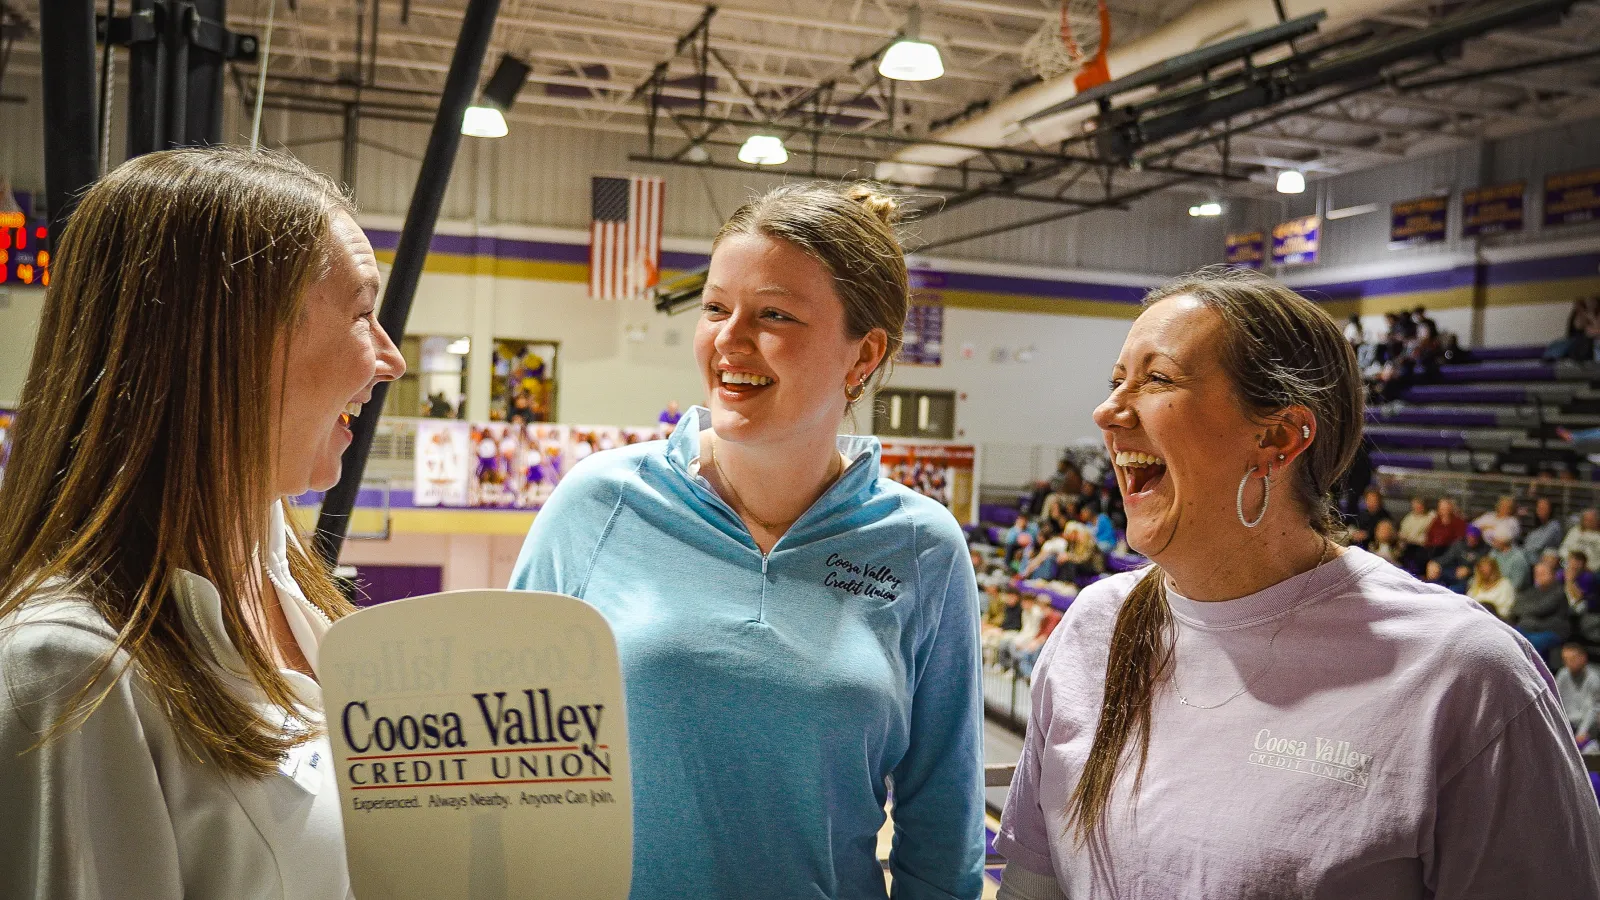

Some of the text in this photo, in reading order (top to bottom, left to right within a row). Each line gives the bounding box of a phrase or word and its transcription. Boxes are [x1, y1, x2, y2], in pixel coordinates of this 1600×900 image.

[824, 571, 896, 601] Credit Union
[826, 553, 902, 589] Coosa Valley
[342, 701, 467, 753] Coosa
[472, 688, 606, 763] Valley
[1254, 728, 1373, 772] Coosa Valley
[349, 752, 611, 784] CREDIT UNION
[1248, 752, 1369, 787] CREDIT UNION
[428, 794, 467, 810] Always
[469, 791, 512, 808] Nearby.
[520, 791, 562, 808] Anyone
[565, 789, 588, 804] Can
